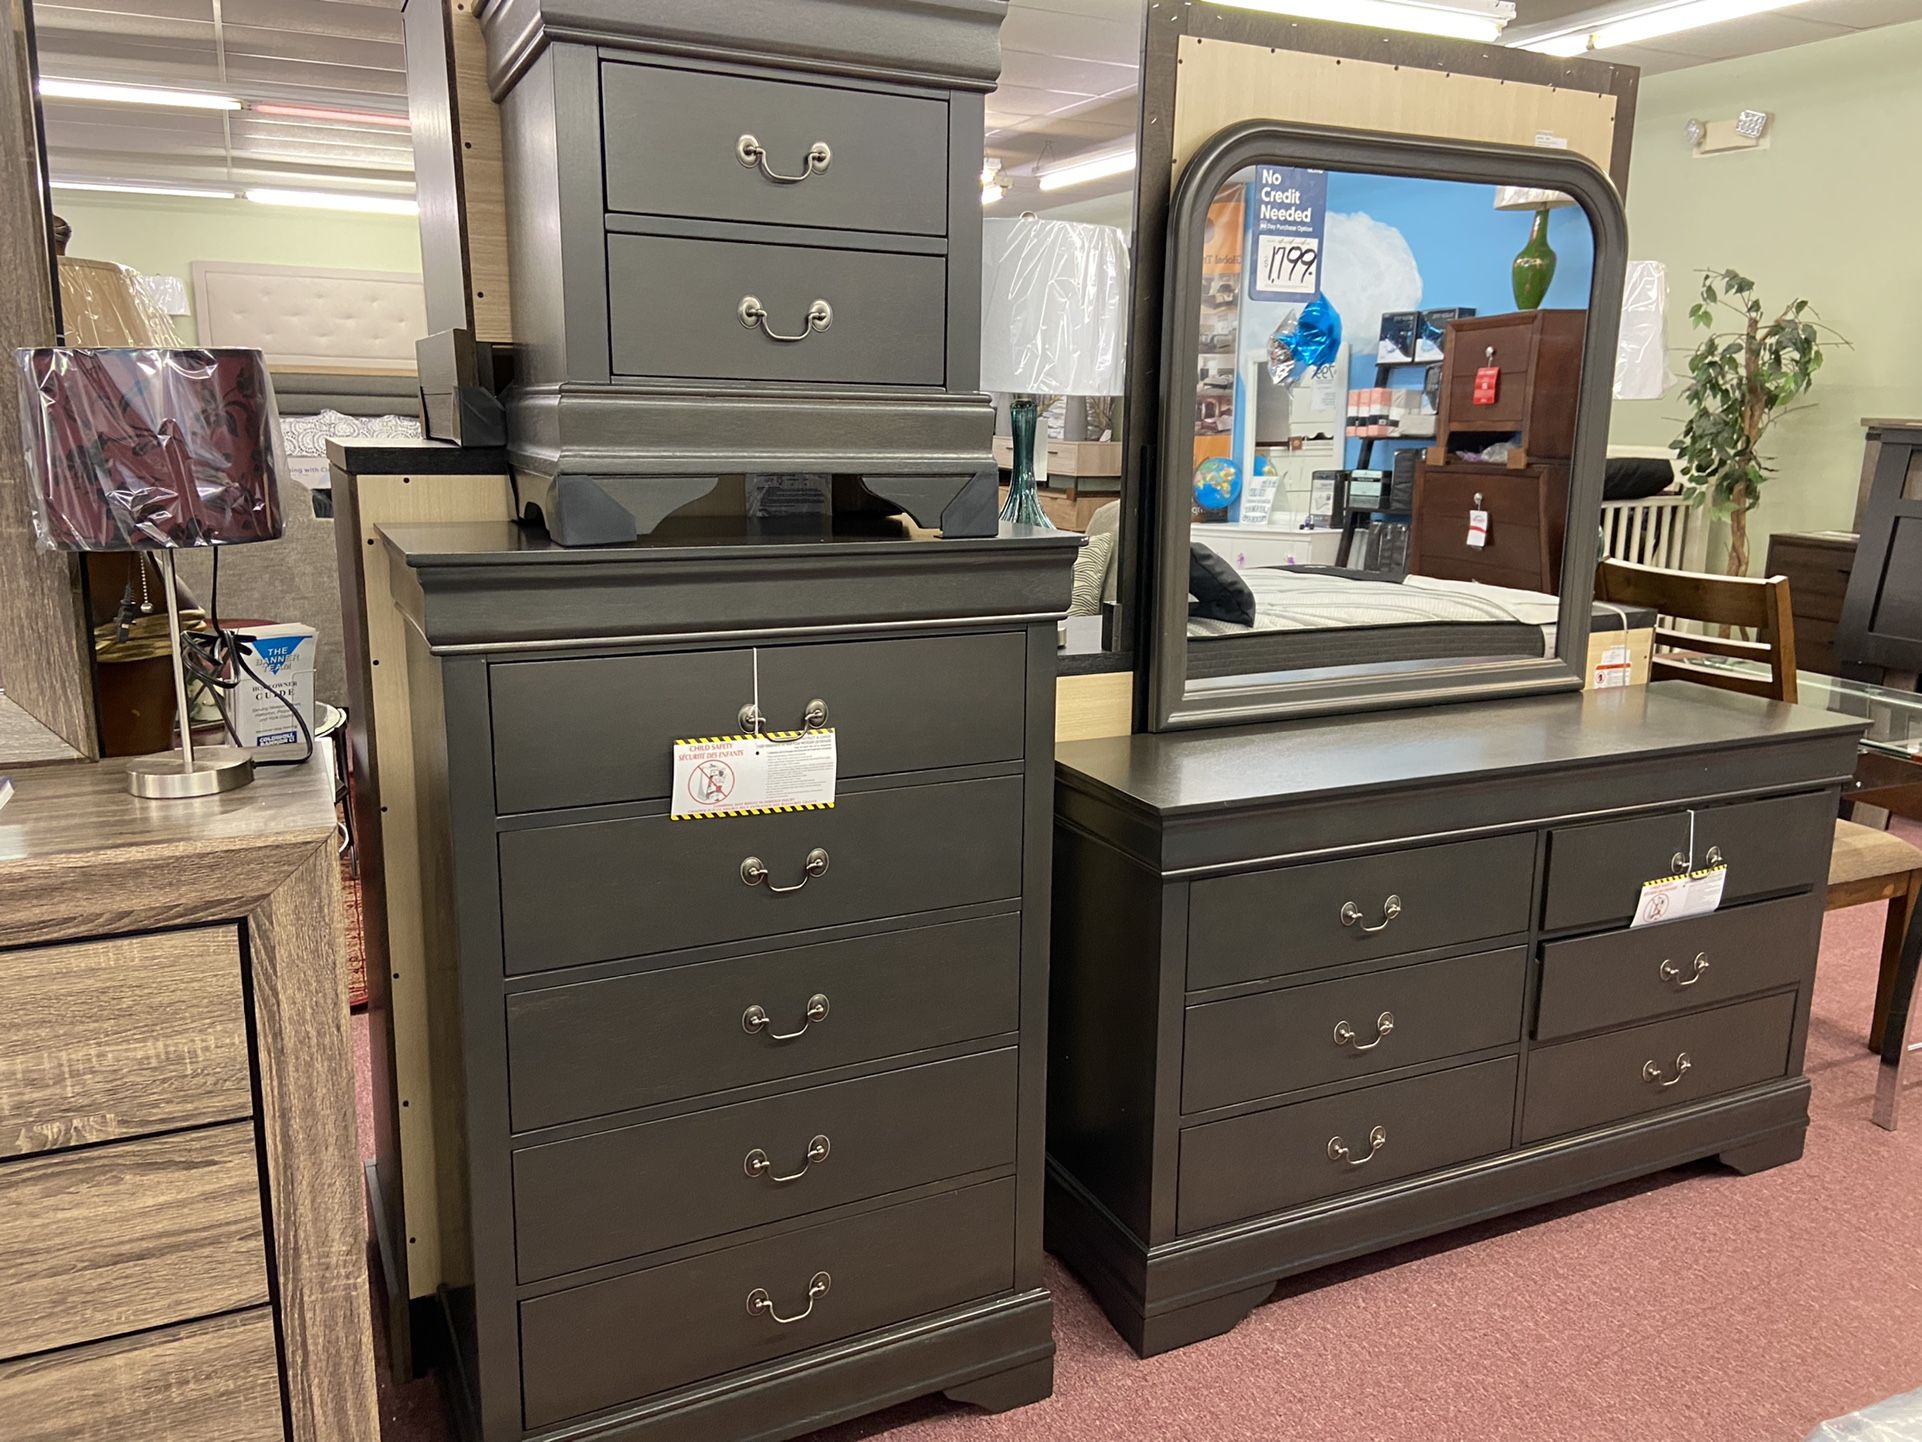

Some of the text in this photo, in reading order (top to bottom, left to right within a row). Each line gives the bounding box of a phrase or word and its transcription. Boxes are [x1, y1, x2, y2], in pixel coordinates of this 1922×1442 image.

[1262, 168, 1282, 185] No
[1261, 187, 1301, 204] Credit
[1260, 204, 1312, 222] Needed
[268, 646, 289, 656] THE
[256, 654, 300, 667] BANNER
[255, 689, 295, 701] GUDE
[689, 742, 733, 752] CHILD SAFETY
